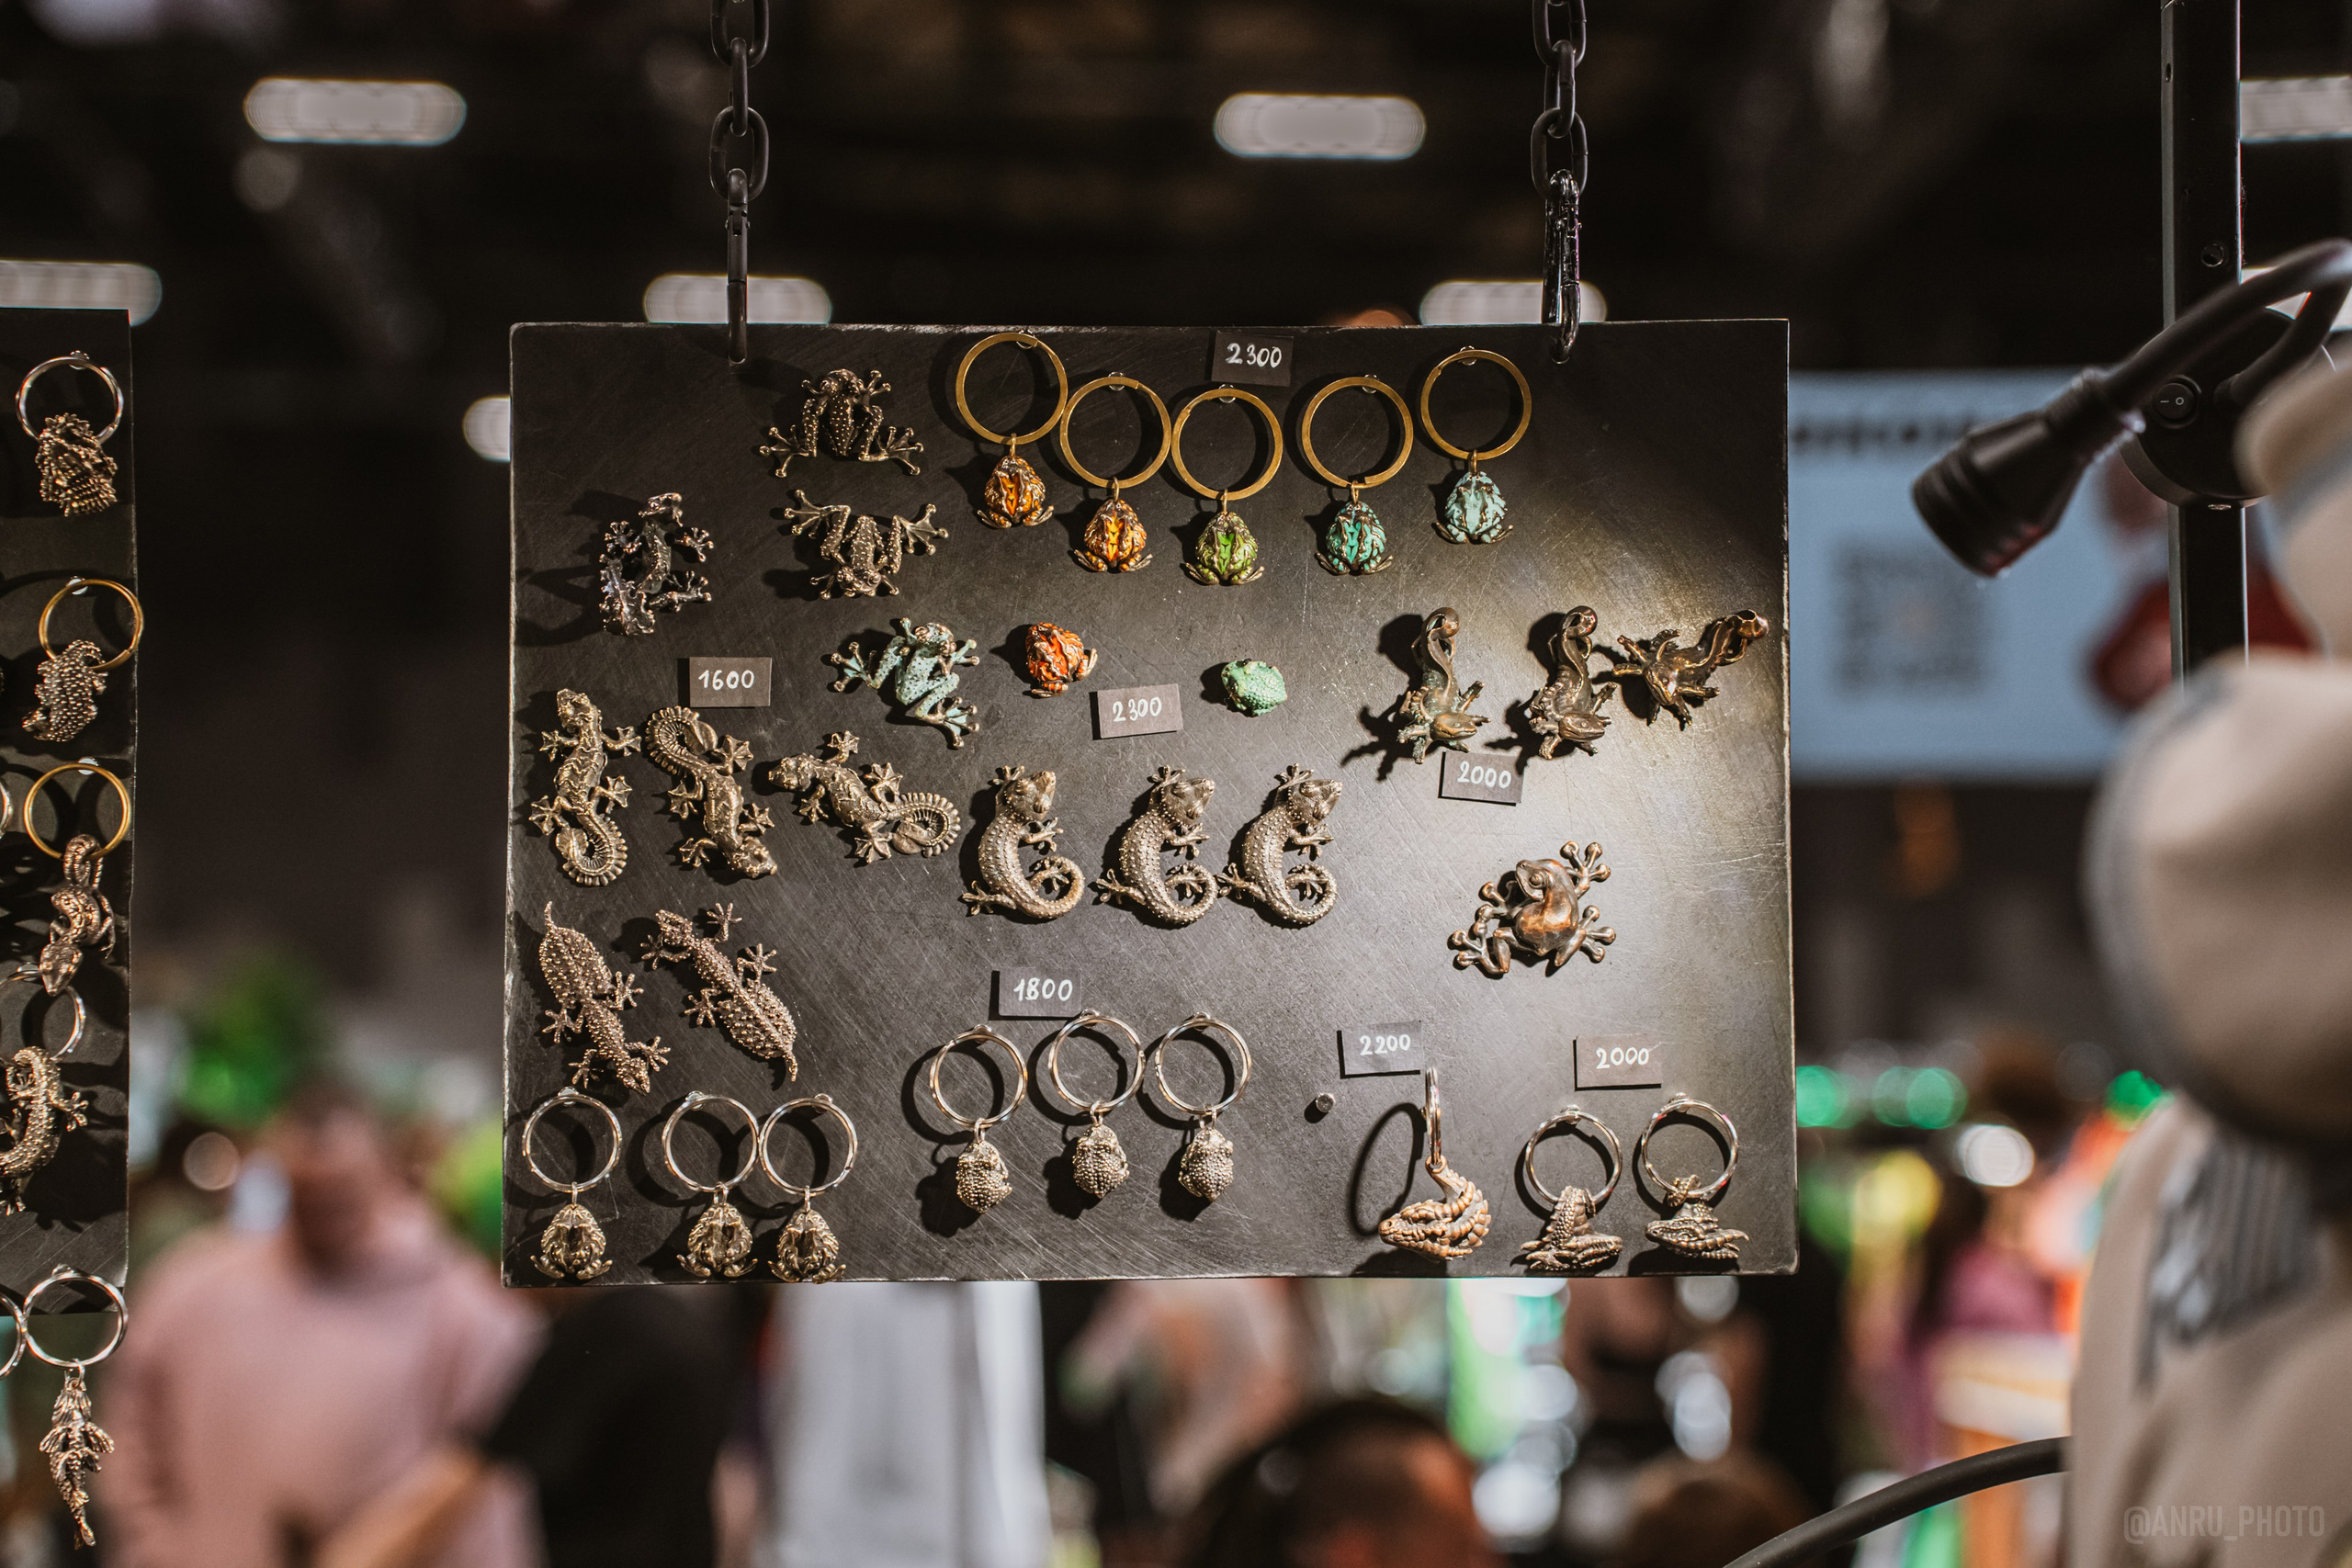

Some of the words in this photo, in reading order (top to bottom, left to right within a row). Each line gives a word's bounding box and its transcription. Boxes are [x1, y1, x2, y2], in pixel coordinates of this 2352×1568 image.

[1225, 342, 1282, 368] 2300
[698, 669, 755, 691] 1600
[1113, 696, 1162, 722] 2300
[1457, 761, 1511, 789] 2000
[1013, 977, 1073, 1001] 1800
[1360, 1034, 1411, 1055] 2200
[1596, 1047, 1649, 1069] 2000
